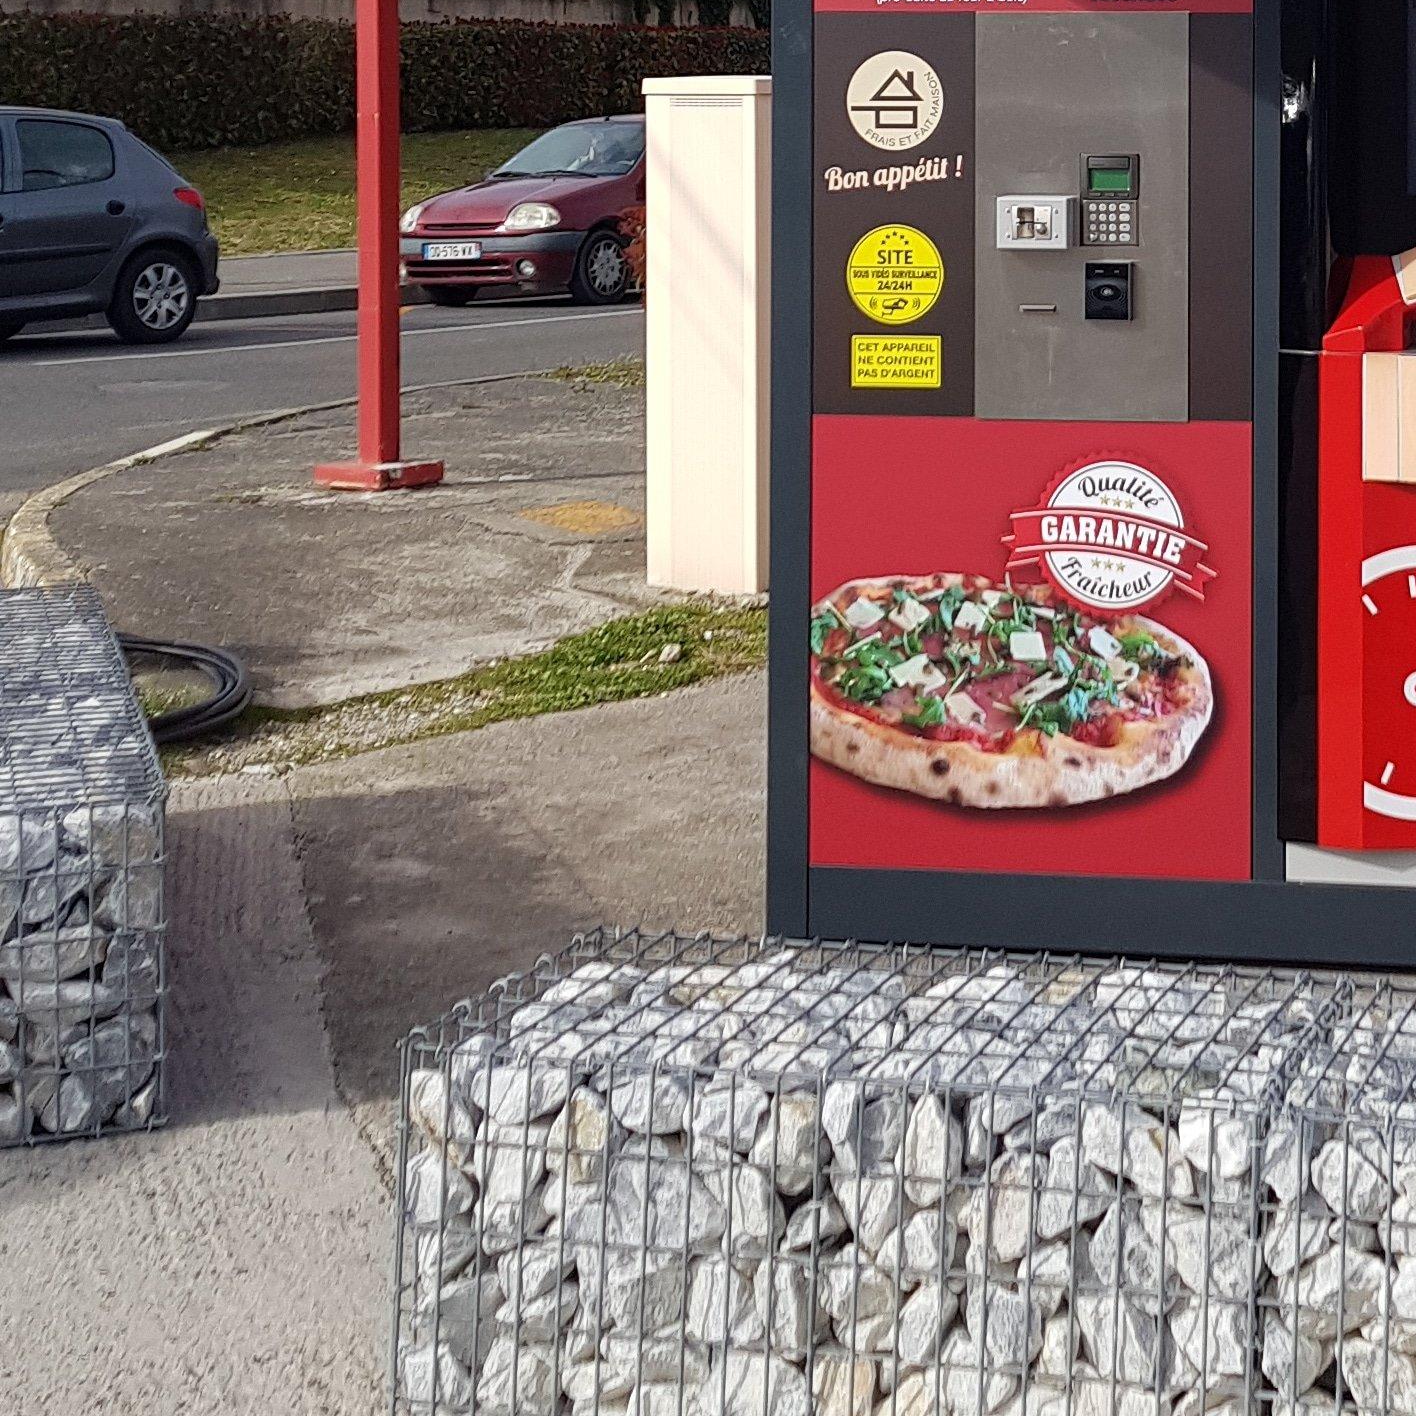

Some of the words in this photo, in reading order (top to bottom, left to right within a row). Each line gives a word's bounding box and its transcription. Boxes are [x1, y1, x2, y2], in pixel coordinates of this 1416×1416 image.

[864, 126, 897, 148] FRAIS
[898, 133, 914, 147] ET
[912, 117, 934, 144] FAIT
[924, 69, 941, 119] MAISON
[824, 164, 870, 192] Bon
[873, 156, 949, 192] appétit
[876, 249, 914, 266] SITE
[857, 342, 879, 352] CET
[882, 342, 936, 352] APPAREIL
[857, 355, 874, 365] NE
[877, 355, 936, 365] CONTIENT
[857, 368, 878, 378] PAS
[880, 368, 936, 378] D'ARGENT
[1077, 474, 1164, 509] Qualité
[1041, 515, 1187, 565] GARANTIE
[1061, 556, 1152, 599] Fraîcheur
